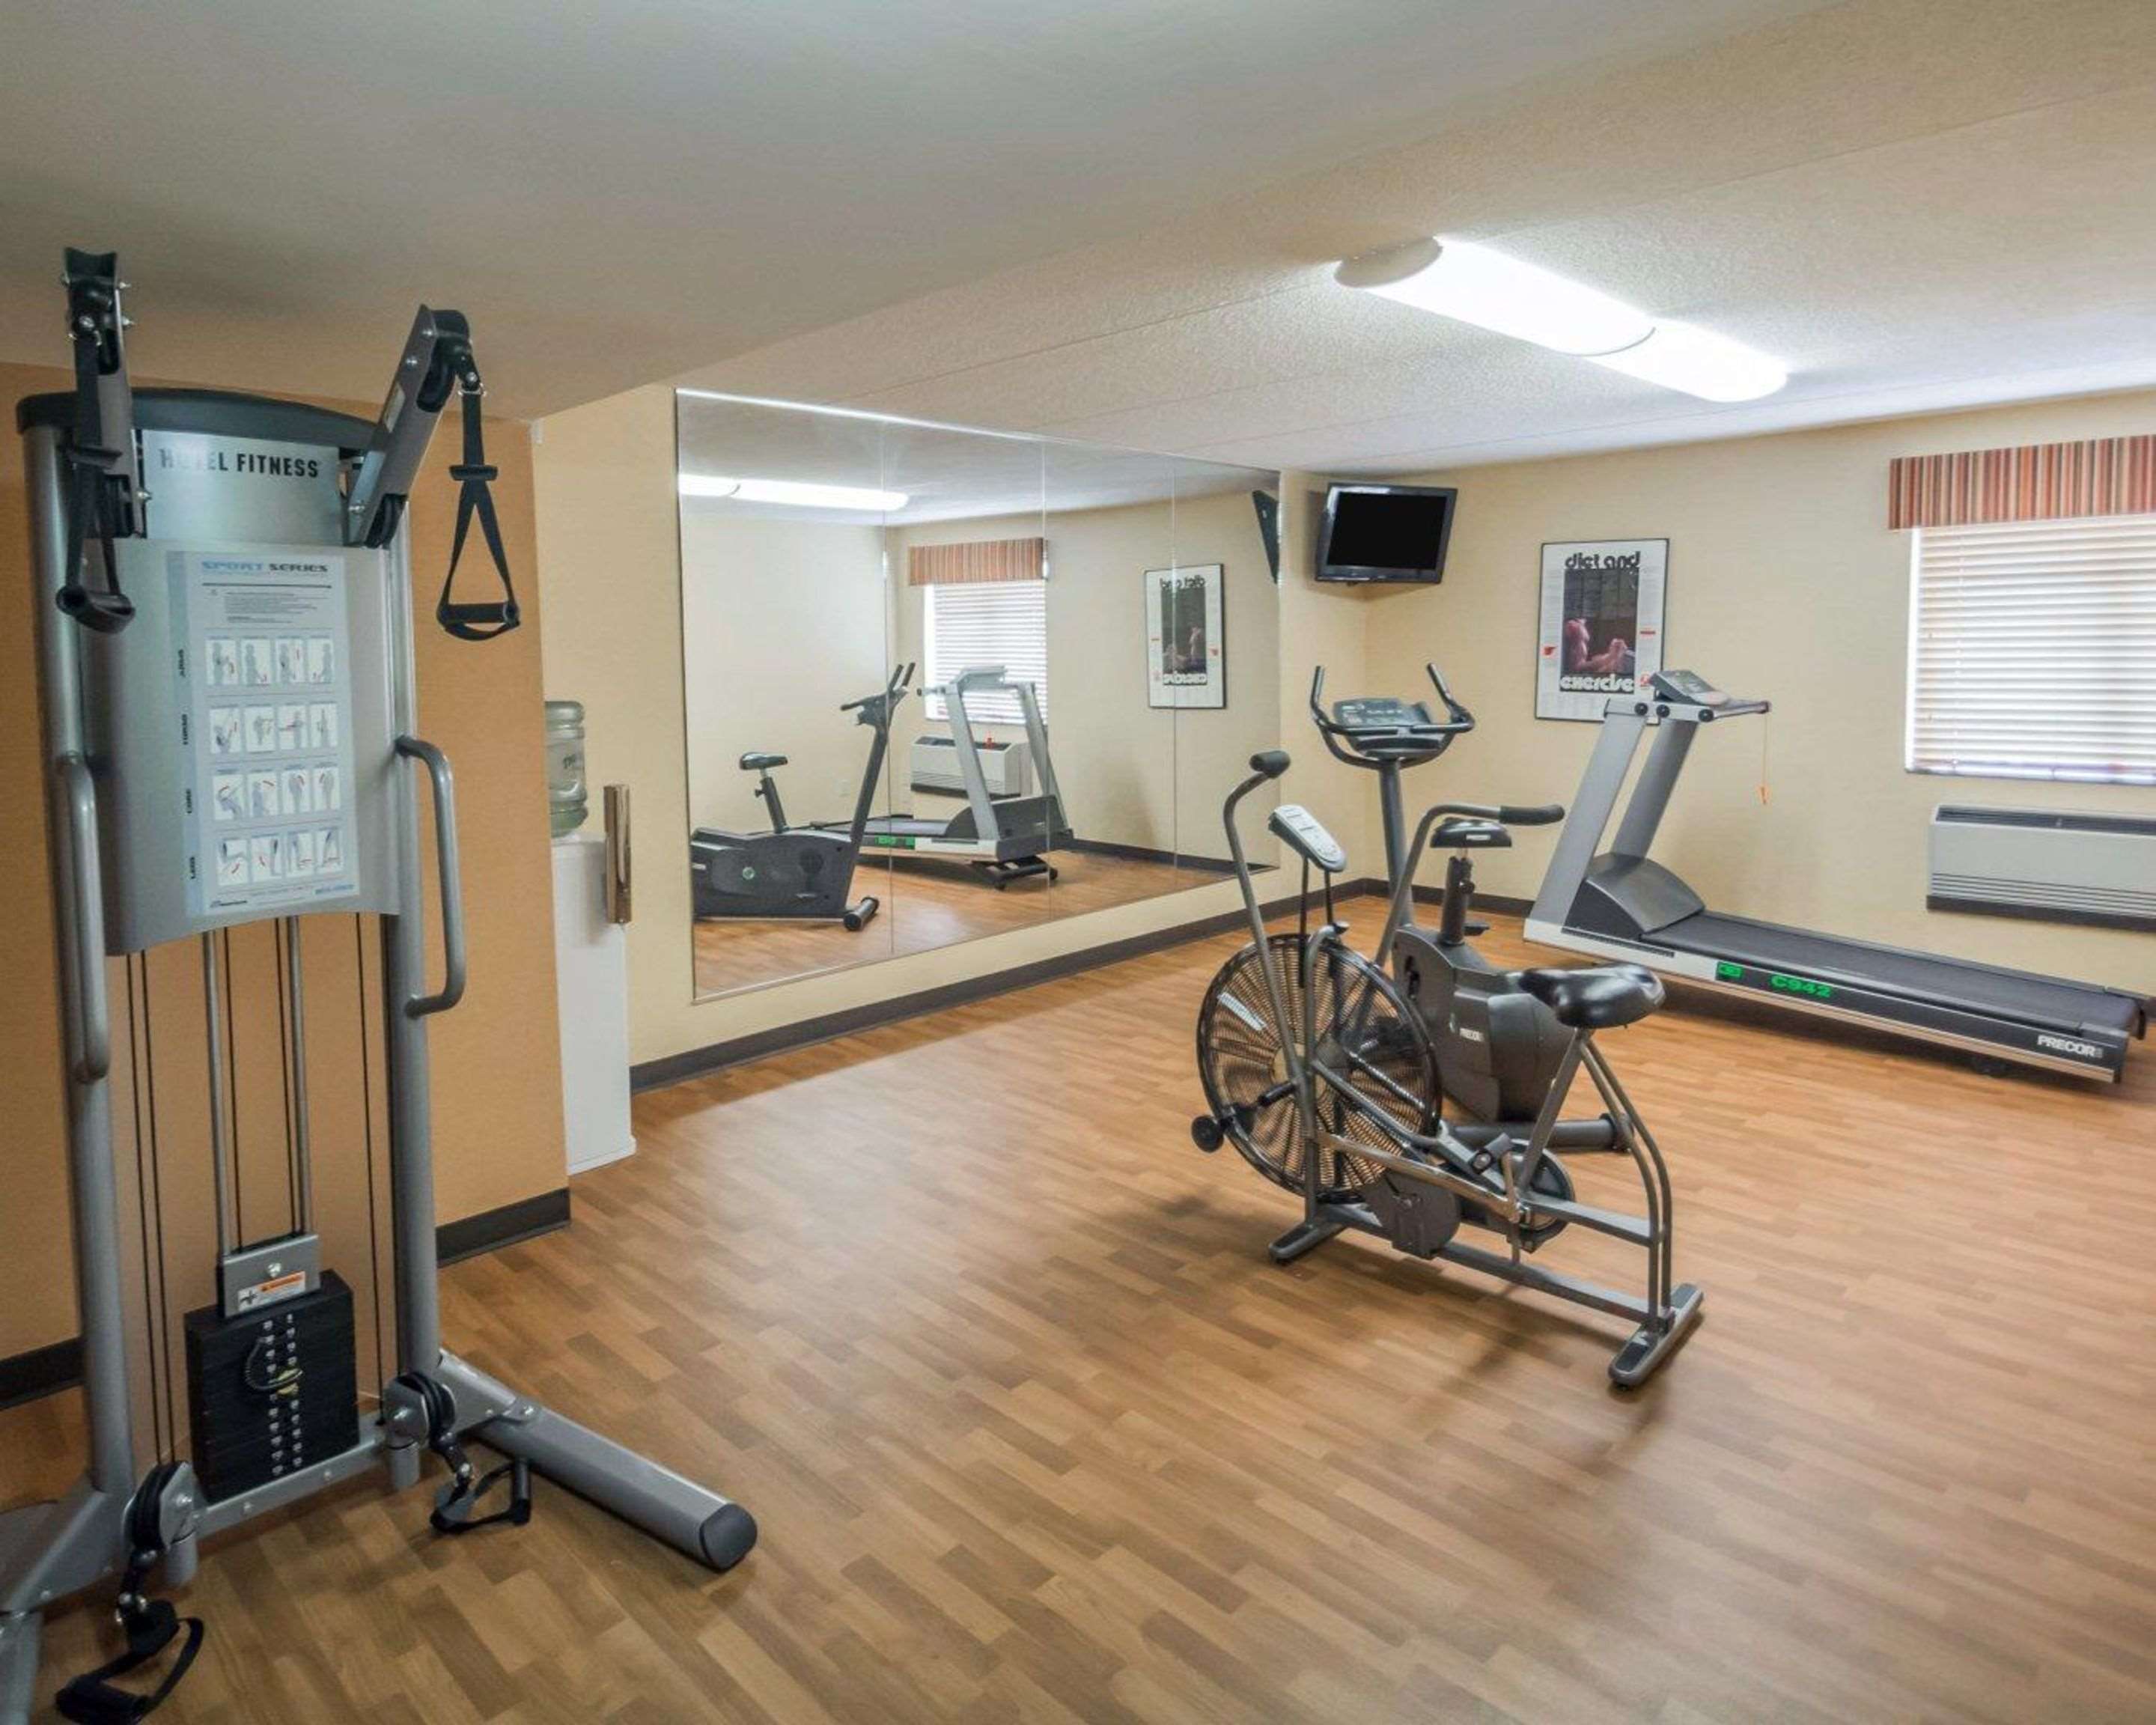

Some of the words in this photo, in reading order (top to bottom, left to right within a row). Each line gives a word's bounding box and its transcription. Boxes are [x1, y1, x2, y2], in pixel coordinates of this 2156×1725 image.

[159, 448, 228, 471] HEL
[237, 453, 318, 478] FITNESS
[1604, 550, 1641, 569] and
[1559, 674, 1635, 692] exercise
[2036, 1035, 2097, 1057] PRECOR
